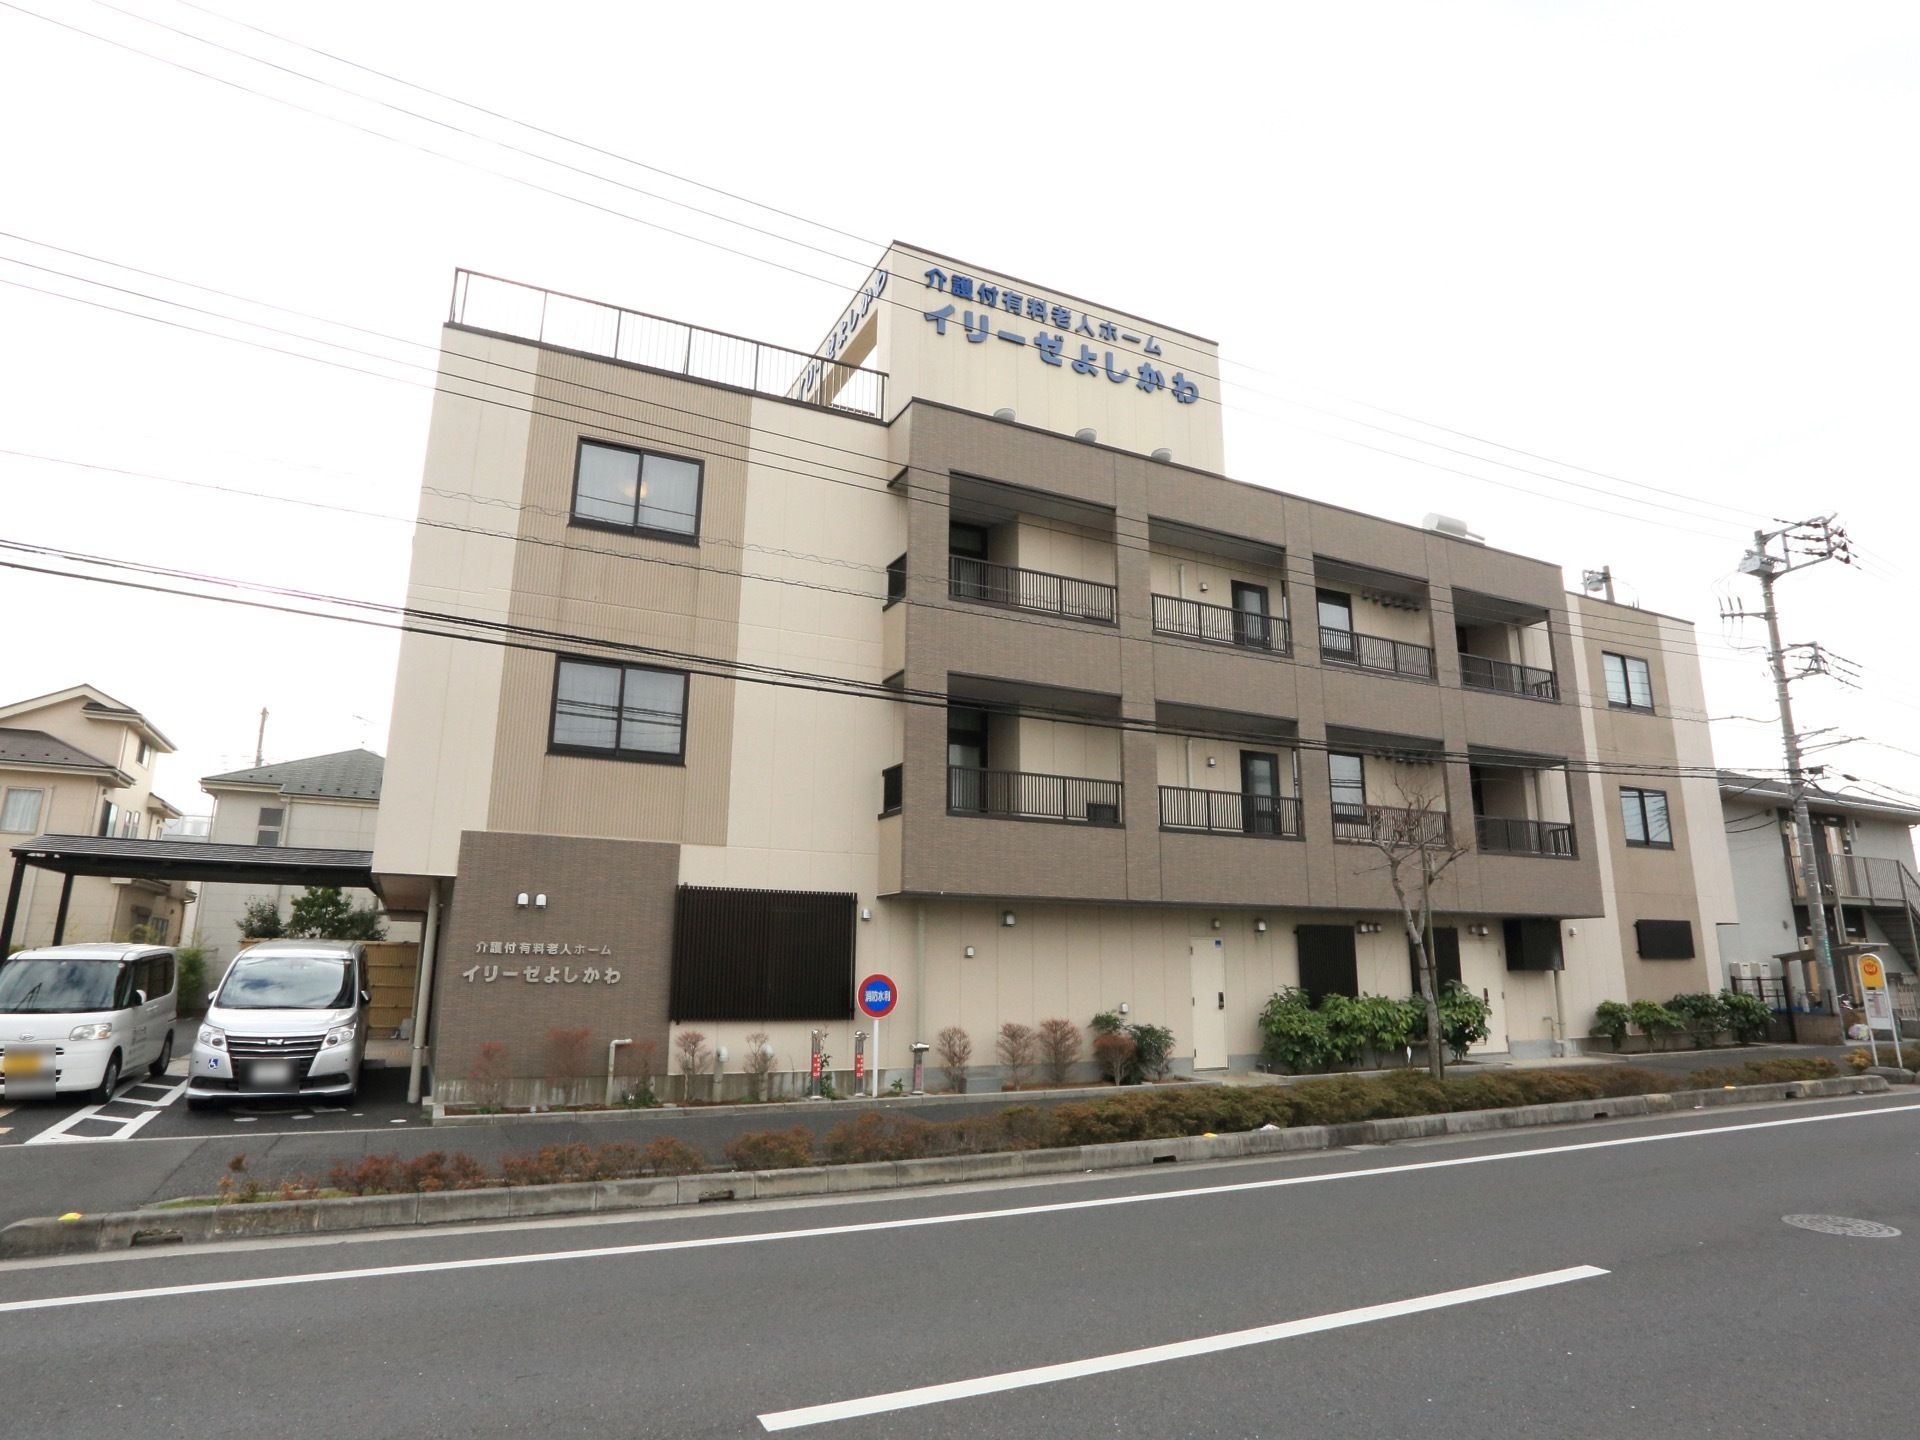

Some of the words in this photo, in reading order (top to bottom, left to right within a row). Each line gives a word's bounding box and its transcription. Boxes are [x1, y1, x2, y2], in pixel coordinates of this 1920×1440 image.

[924, 267, 1162, 356] 介護付有料老人ホーム
[923, 303, 1200, 404] イリーゼよしかわ
[475, 940, 612, 956] 介護付有料老人ホーム
[462, 964, 622, 985] イリーゼよしかわ
[864, 990, 891, 1002] 消防水利
